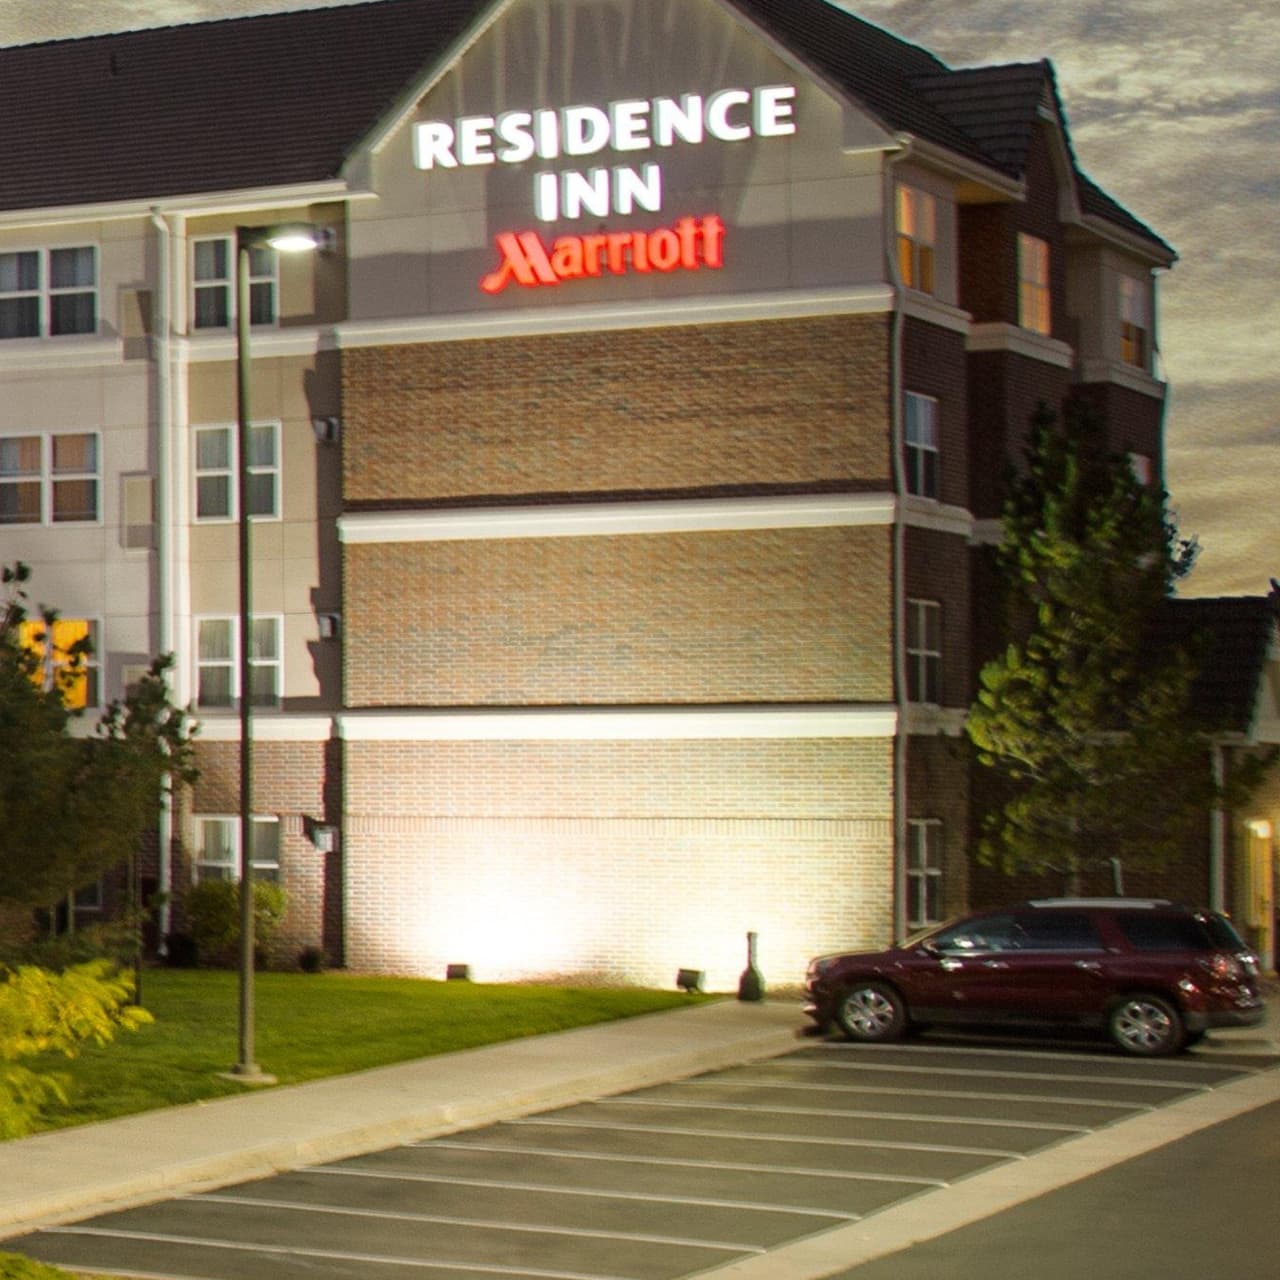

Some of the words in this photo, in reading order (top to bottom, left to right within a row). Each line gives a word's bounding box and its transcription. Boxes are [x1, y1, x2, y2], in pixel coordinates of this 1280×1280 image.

[413, 86, 796, 170] RESIDENCE
[534, 163, 662, 221] INN
[479, 216, 725, 294] Marriott
